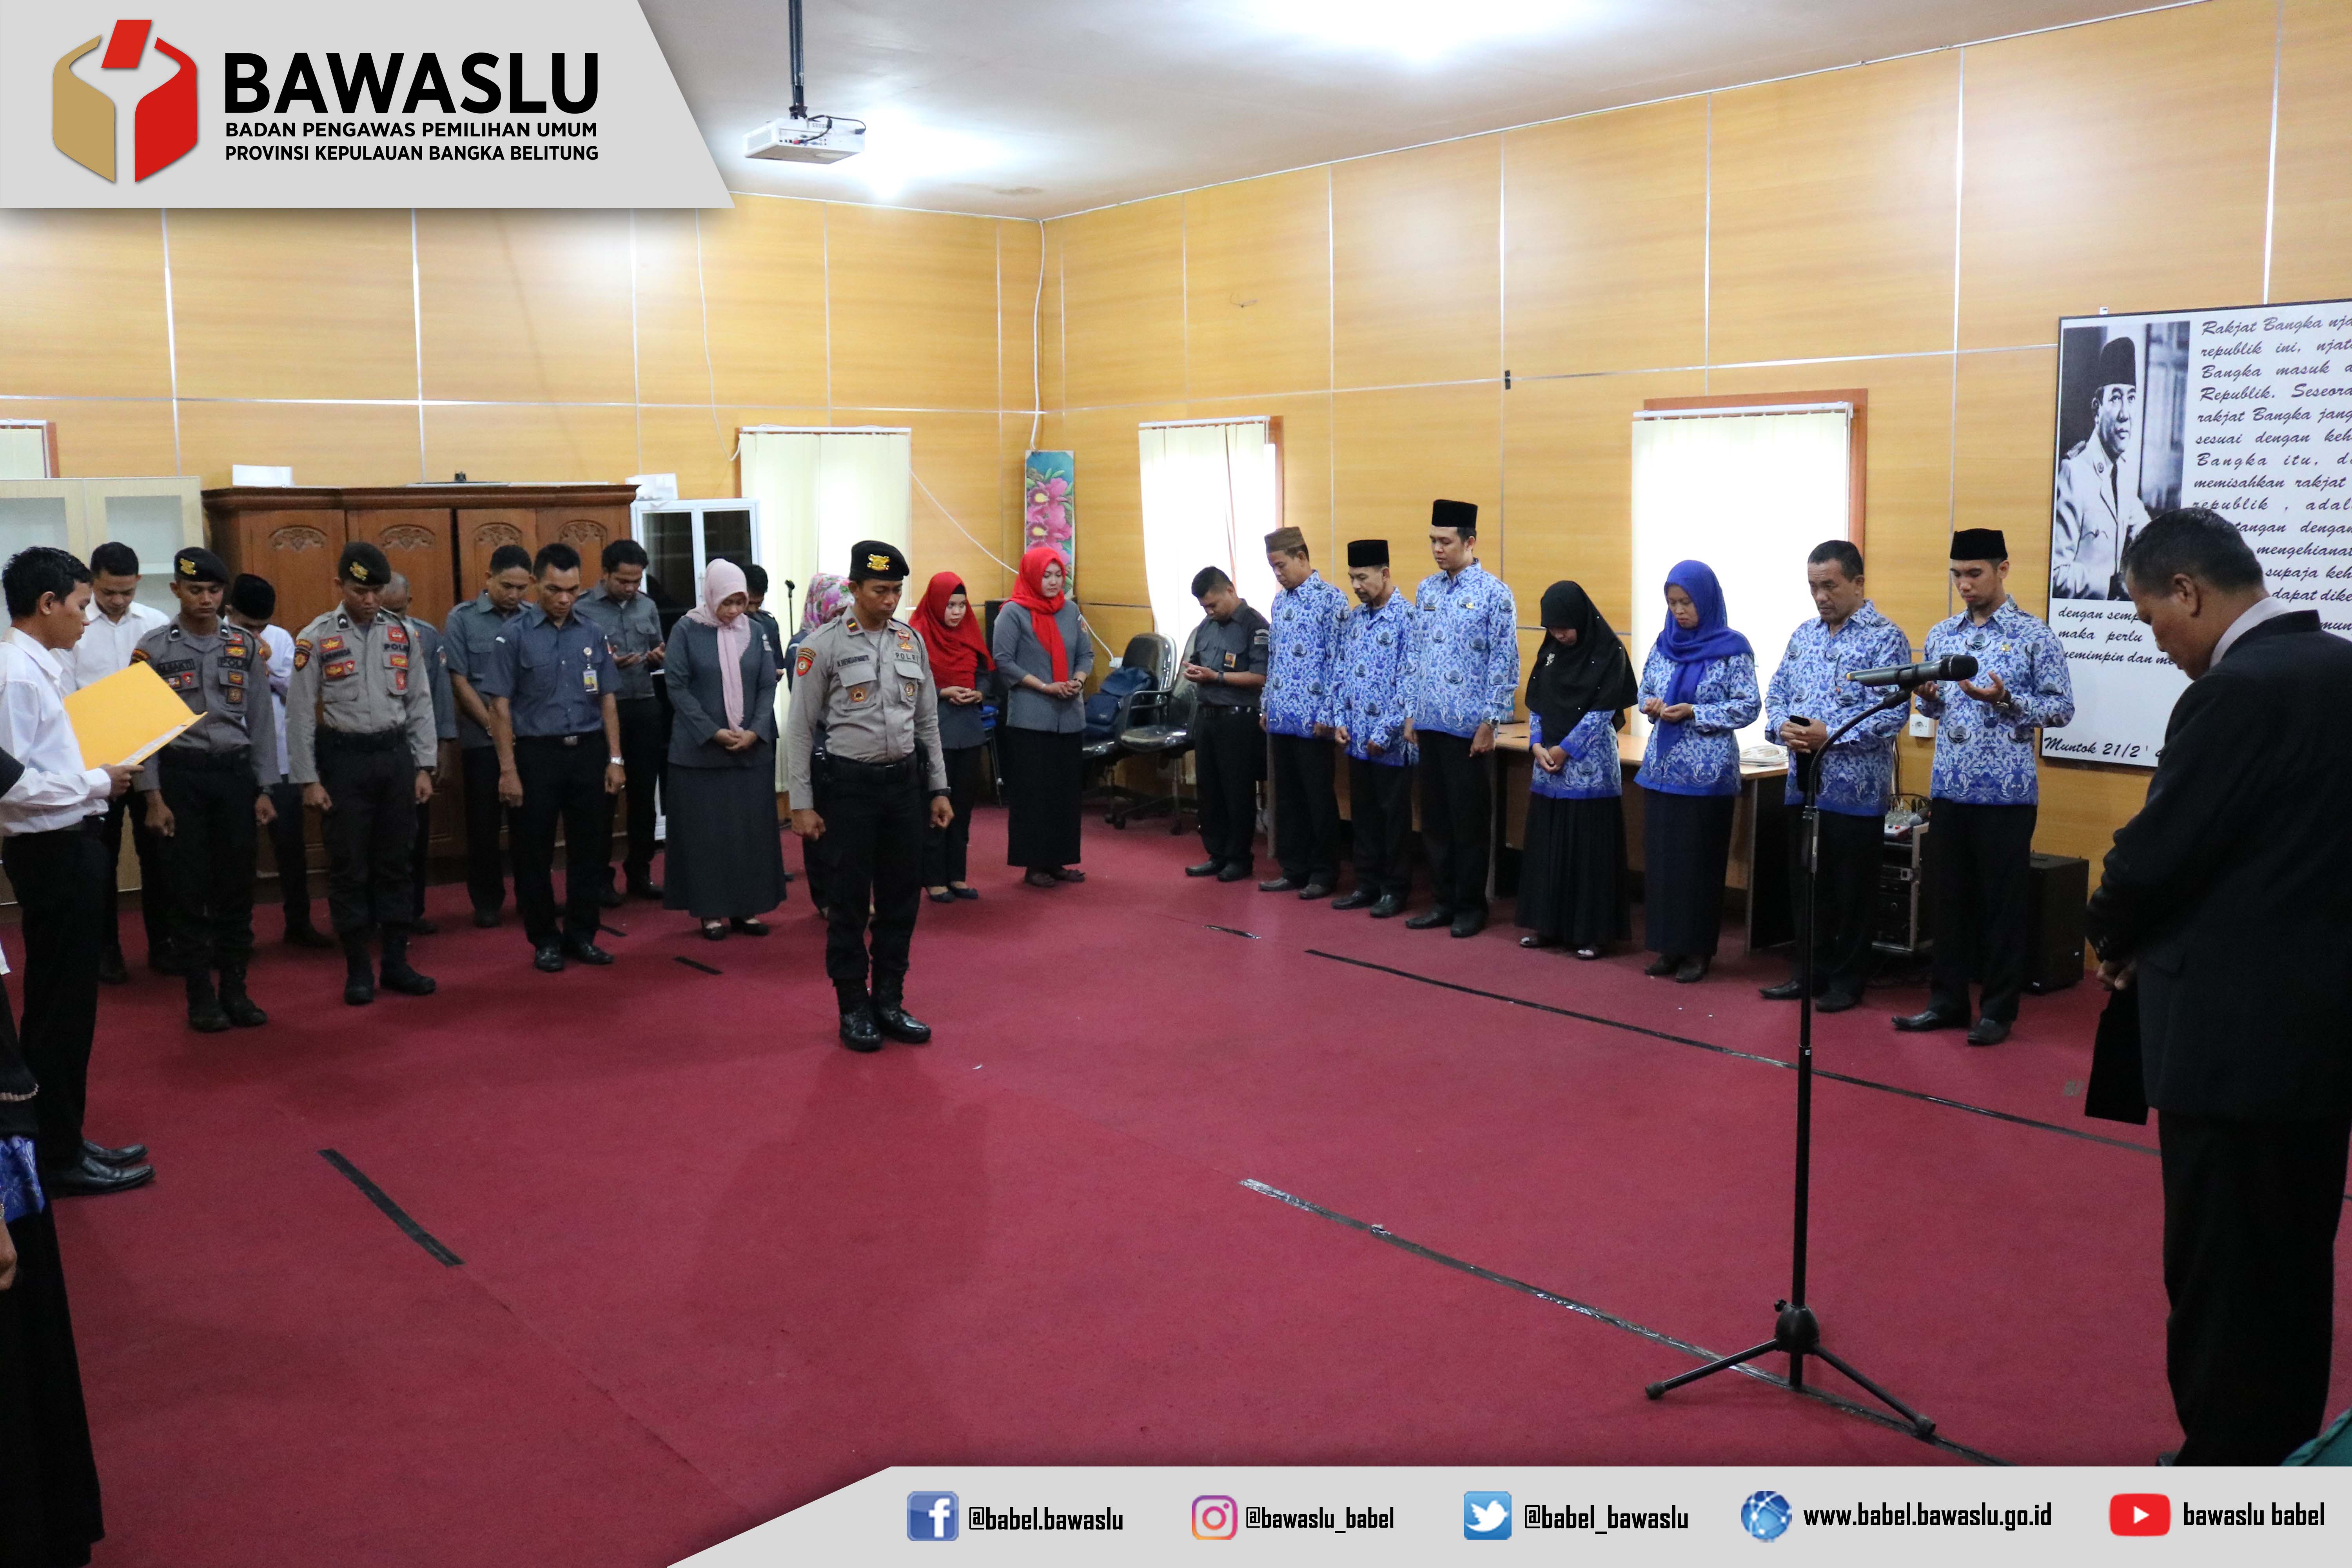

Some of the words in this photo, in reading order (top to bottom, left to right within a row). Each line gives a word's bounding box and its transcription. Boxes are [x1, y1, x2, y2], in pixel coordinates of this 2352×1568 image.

[2202, 320, 2257, 336] Rakjat
[2263, 315, 2323, 333] Bangka
[2201, 341, 2262, 359] republik
[2276, 342, 2301, 353] ini,
[2317, 339, 2352, 354] njat
[2201, 364, 2262, 381] Bangka
[2276, 360, 2330, 375] masuk
[2200, 385, 2275, 403] Republik.
[2197, 409, 2245, 425] rakjat
[2253, 407, 2312, 425] Bangka
[2195, 434, 2243, 444] sesuai
[2255, 431, 2311, 447] dengan
[2197, 452, 2267, 470] Bangka
[2284, 455, 2318, 466] itu,
[2337, 452, 2352, 465] d
[2194, 475, 2285, 488] memisahkan
[2295, 474, 2346, 491] rakjat
[2193, 496, 2269, 510] republik
[2306, 498, 2352, 510] adal
[2265, 567, 2319, 581] supaja
[2272, 587, 2318, 603] dapat
[2058, 606, 2103, 622] dengan
[2321, 621, 2352, 632] mun
[2058, 627, 2095, 639] maka
[2106, 630, 2143, 643] perlu
[895, 652, 918, 662] POLRI
[2127, 652, 2153, 663] dan
[2044, 737, 2097, 754] Muntok
